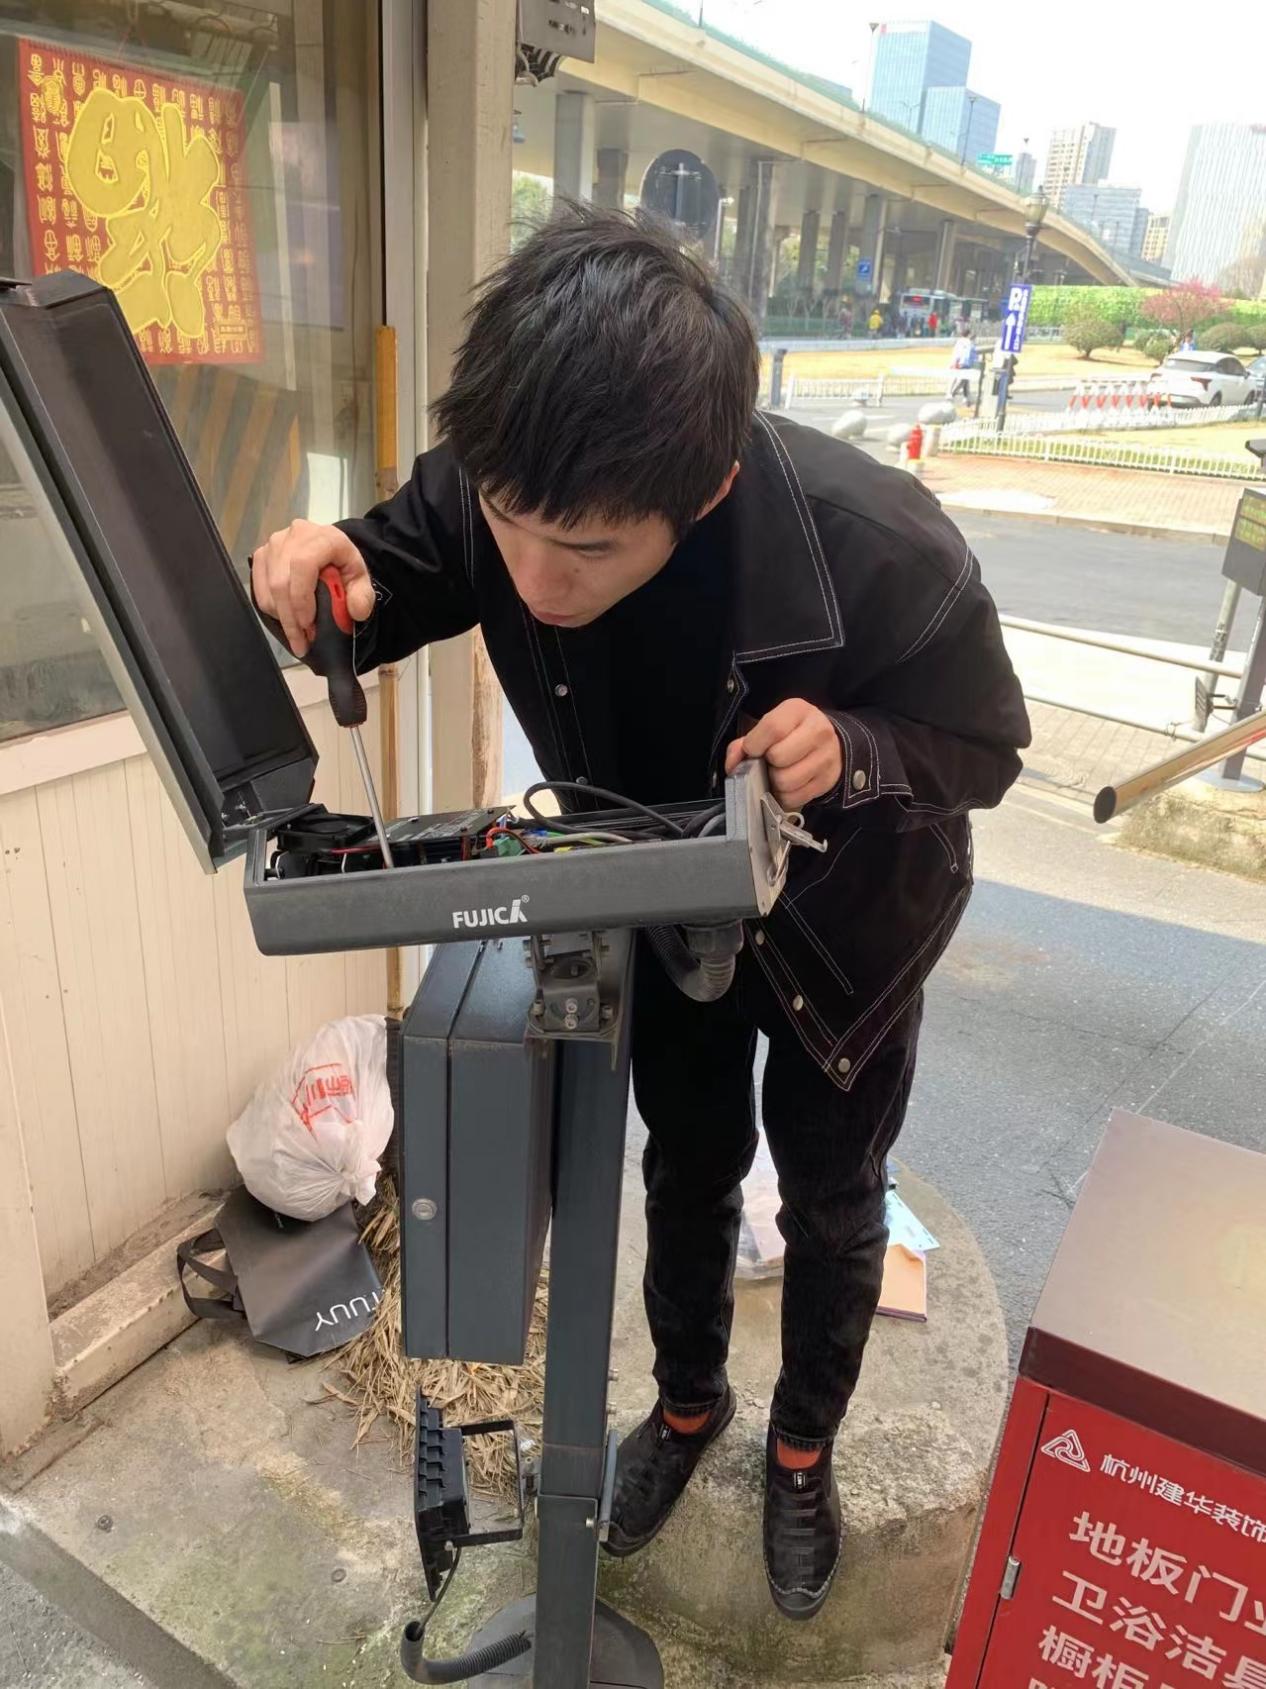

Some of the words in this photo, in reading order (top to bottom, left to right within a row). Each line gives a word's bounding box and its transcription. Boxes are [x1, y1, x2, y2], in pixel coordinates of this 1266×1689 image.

[1100, 1454, 1266, 1543] 杭州建华装饰
[1038, 1624, 1184, 1689] 橱柜
